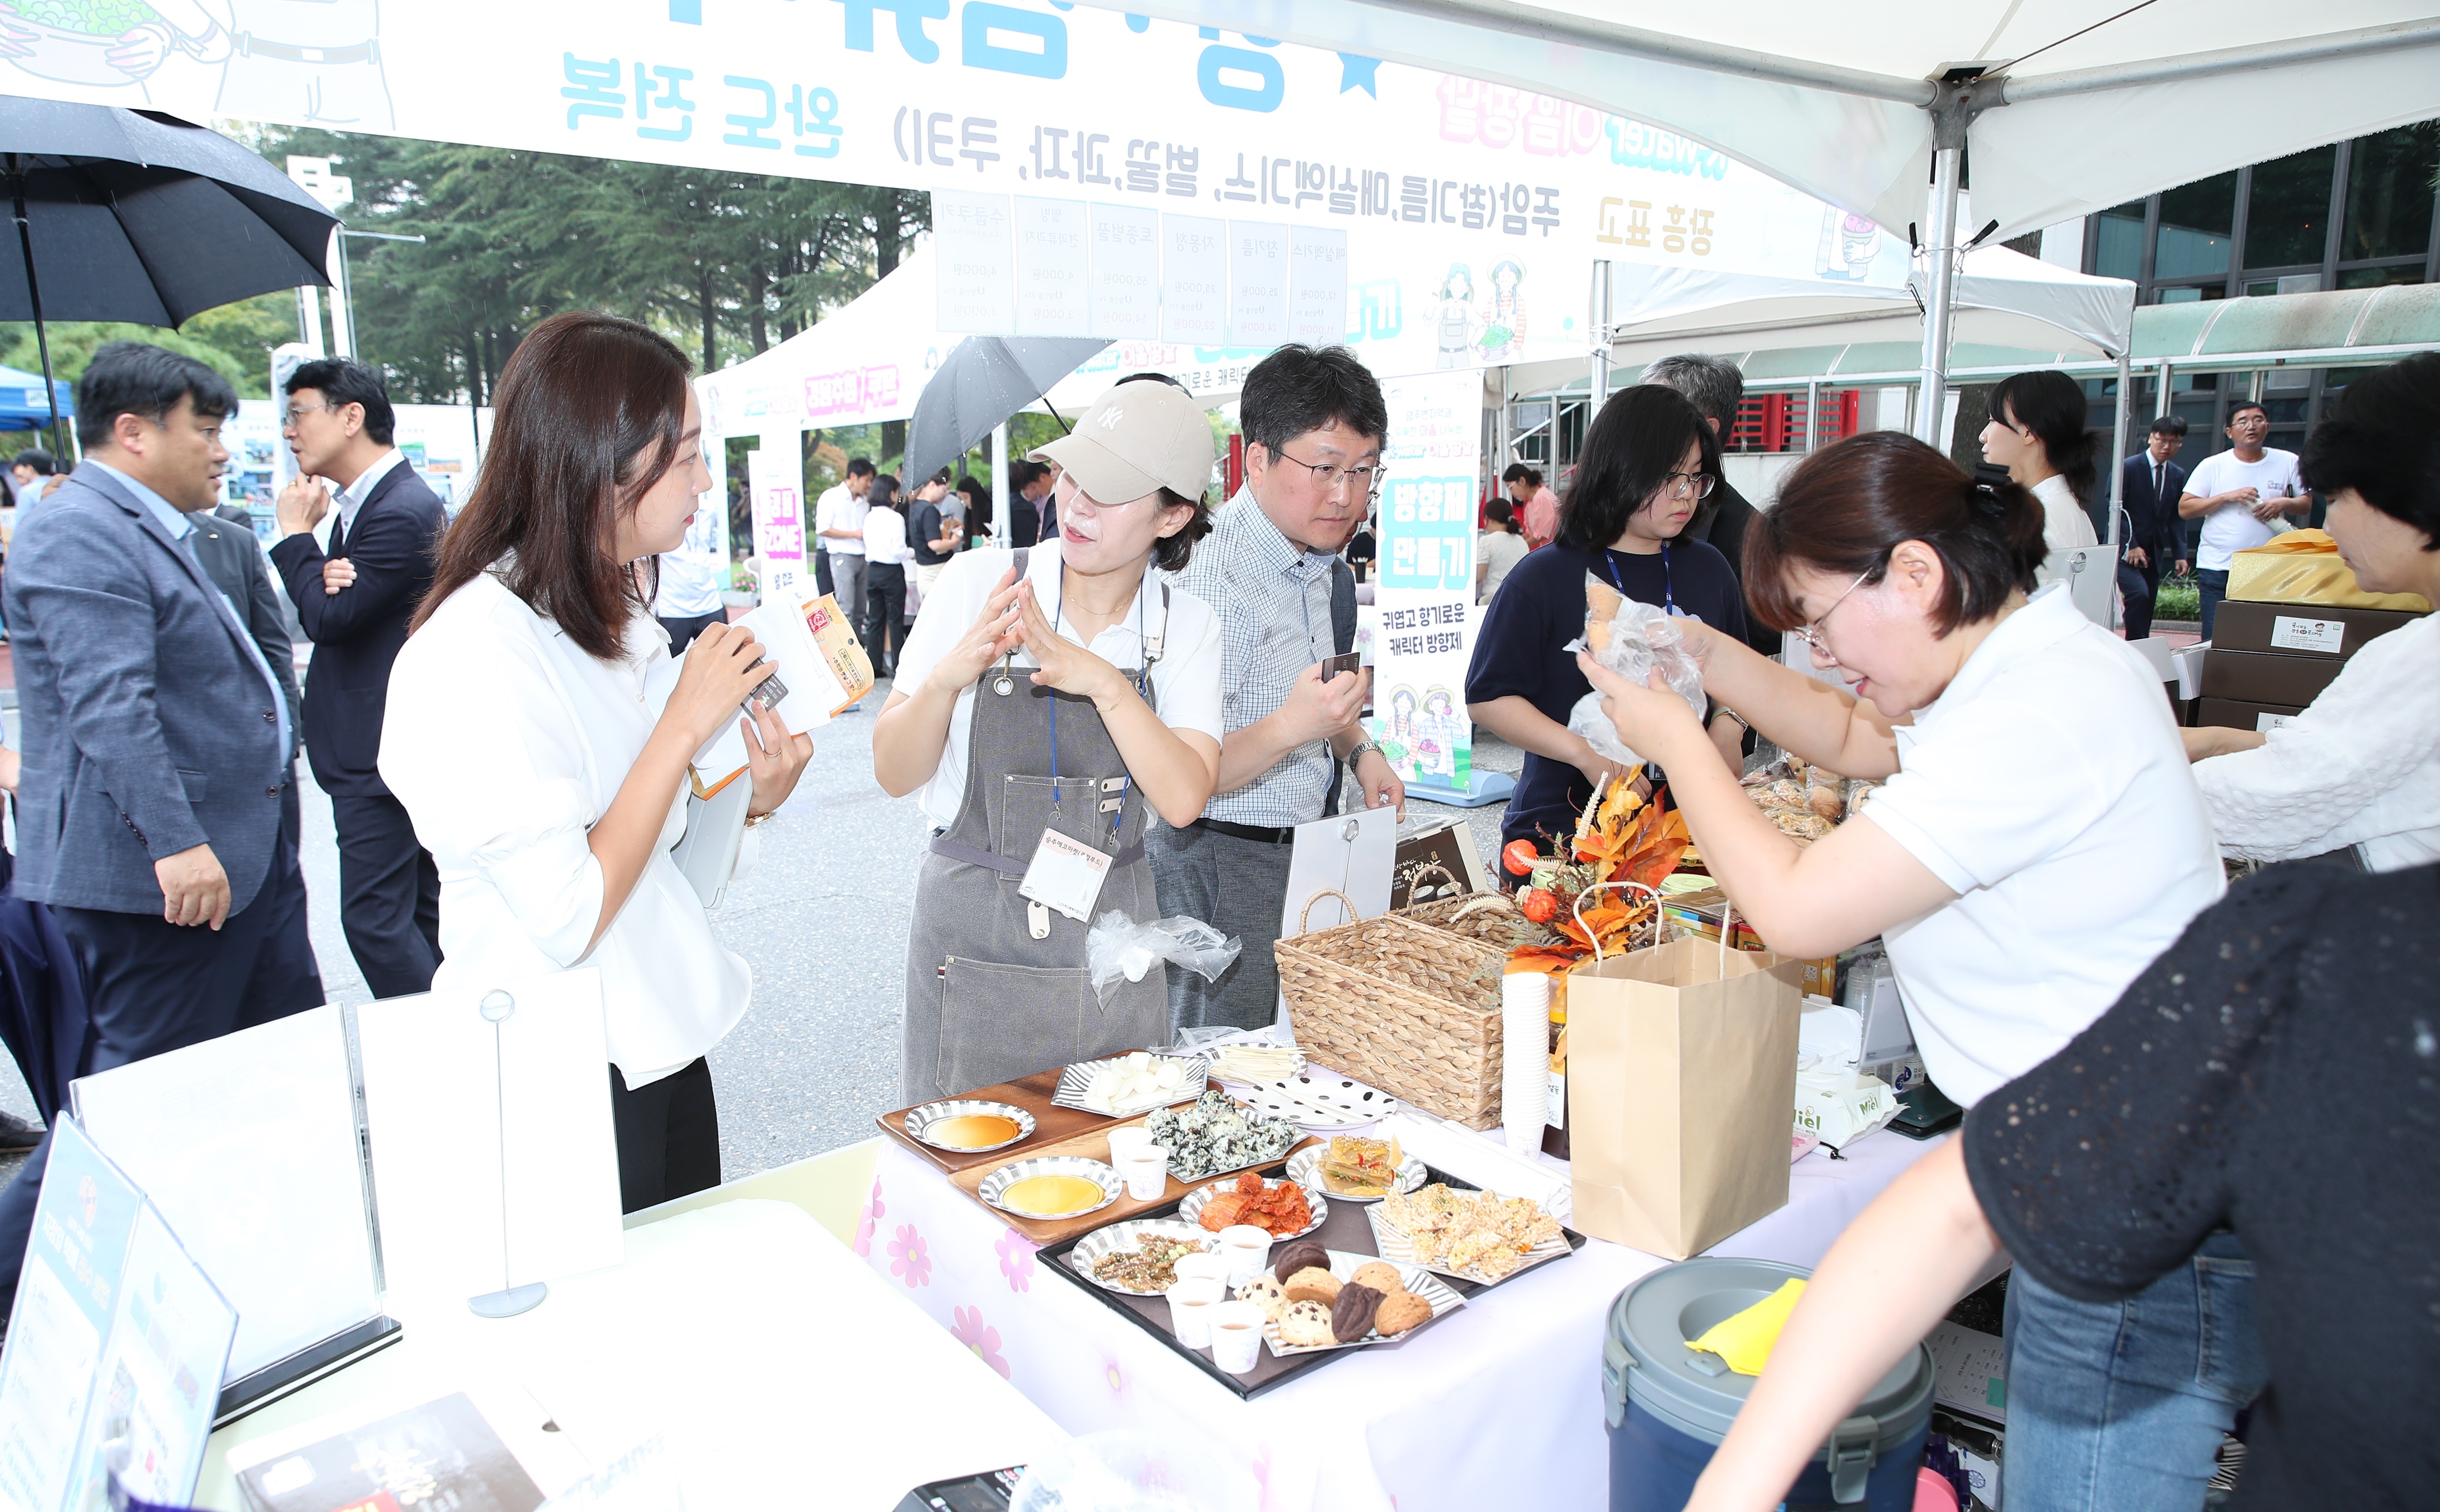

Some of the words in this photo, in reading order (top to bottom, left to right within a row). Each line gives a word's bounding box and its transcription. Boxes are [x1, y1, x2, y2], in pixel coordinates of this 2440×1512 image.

[1406, 408, 1452, 421] 댐주변지역과
[1420, 424, 1436, 436] 마음
[1440, 424, 1462, 434] 나누는
[1387, 445, 1426, 459] K-water
[1393, 481, 1468, 522] 방향제
[765, 525, 800, 553] ZONE
[1392, 537, 1466, 576] 만들기
[1382, 607, 1416, 630] 귀엽고
[1419, 603, 1465, 627] 향기로운
[1389, 635, 1423, 656] 캐릭터
[1426, 631, 1462, 654] 방향제
[1859, 1097, 1879, 1115] Miel
[1794, 1109, 1821, 1130] iel
